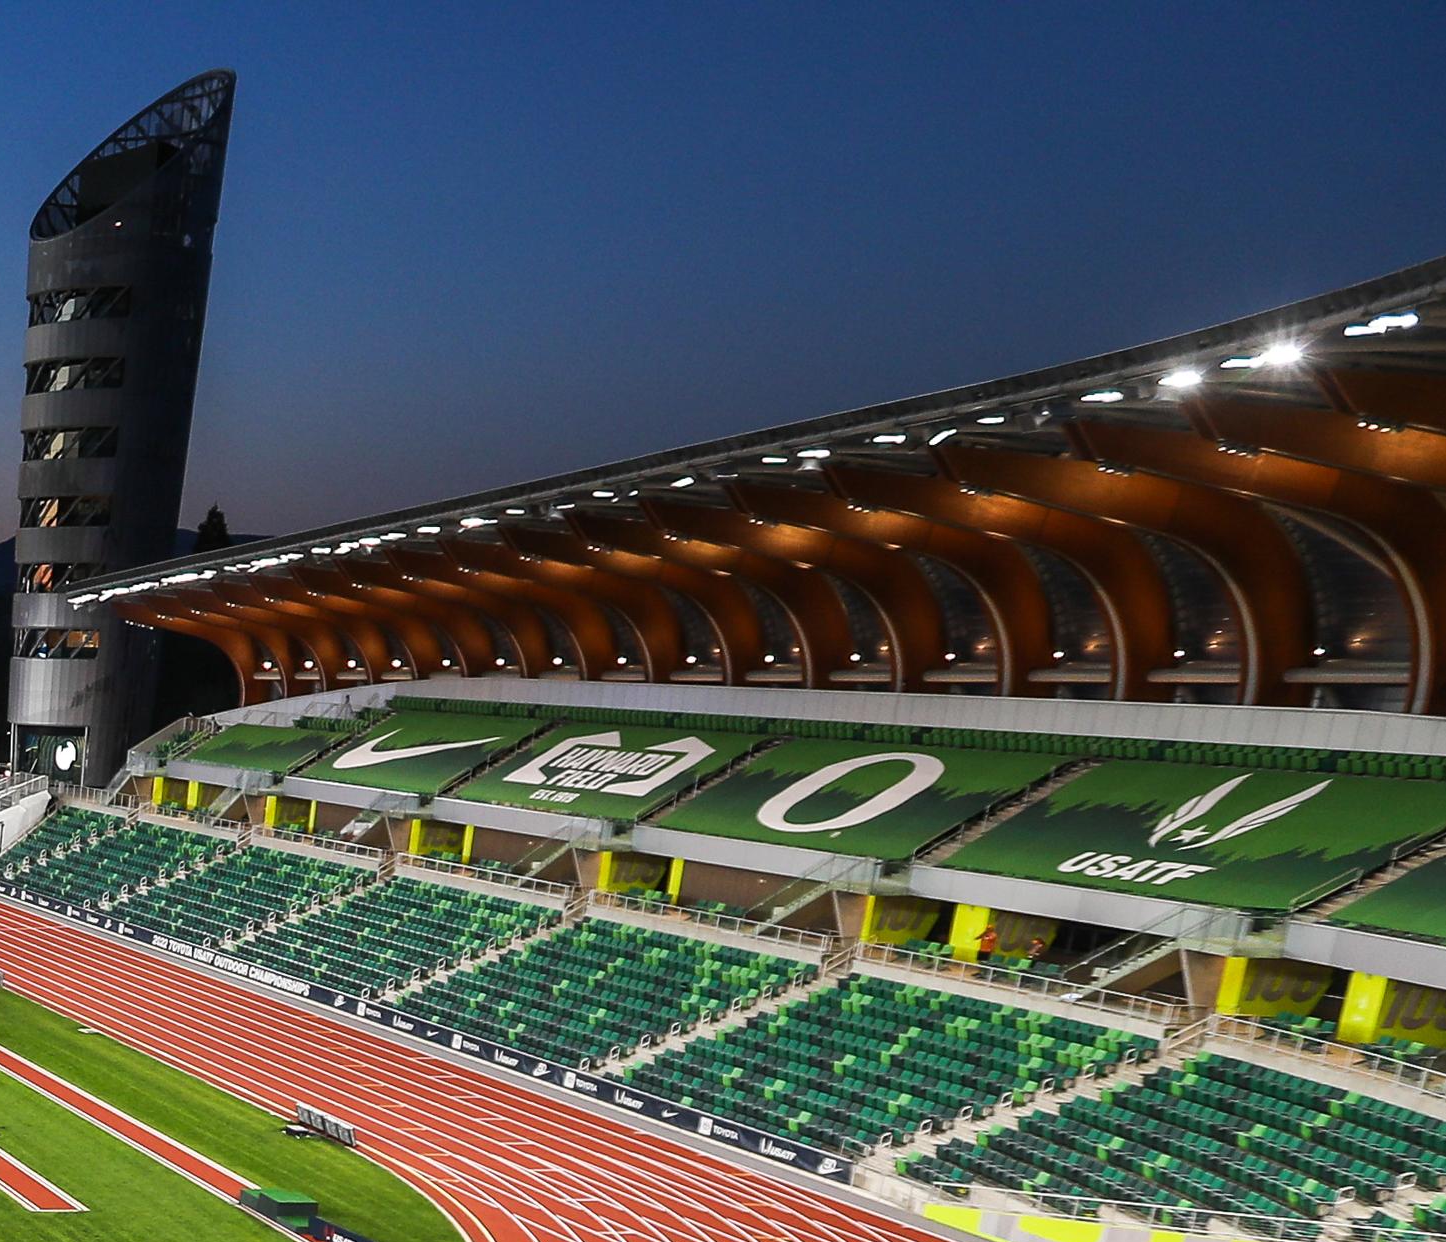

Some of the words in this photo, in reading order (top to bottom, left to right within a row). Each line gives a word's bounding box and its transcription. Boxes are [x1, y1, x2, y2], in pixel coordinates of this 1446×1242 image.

[549, 747, 677, 776] HAYWARD
[546, 769, 618, 790] FIELD
[755, 752, 946, 834] O
[1056, 851, 1217, 884] USATF
[168, 939, 193, 958] TOYOTA
[214, 955, 249, 976] OUTDOOR
[249, 965, 311, 997] CHAMPIONSHIPS
[713, 1124, 739, 1141] TOYOTA
